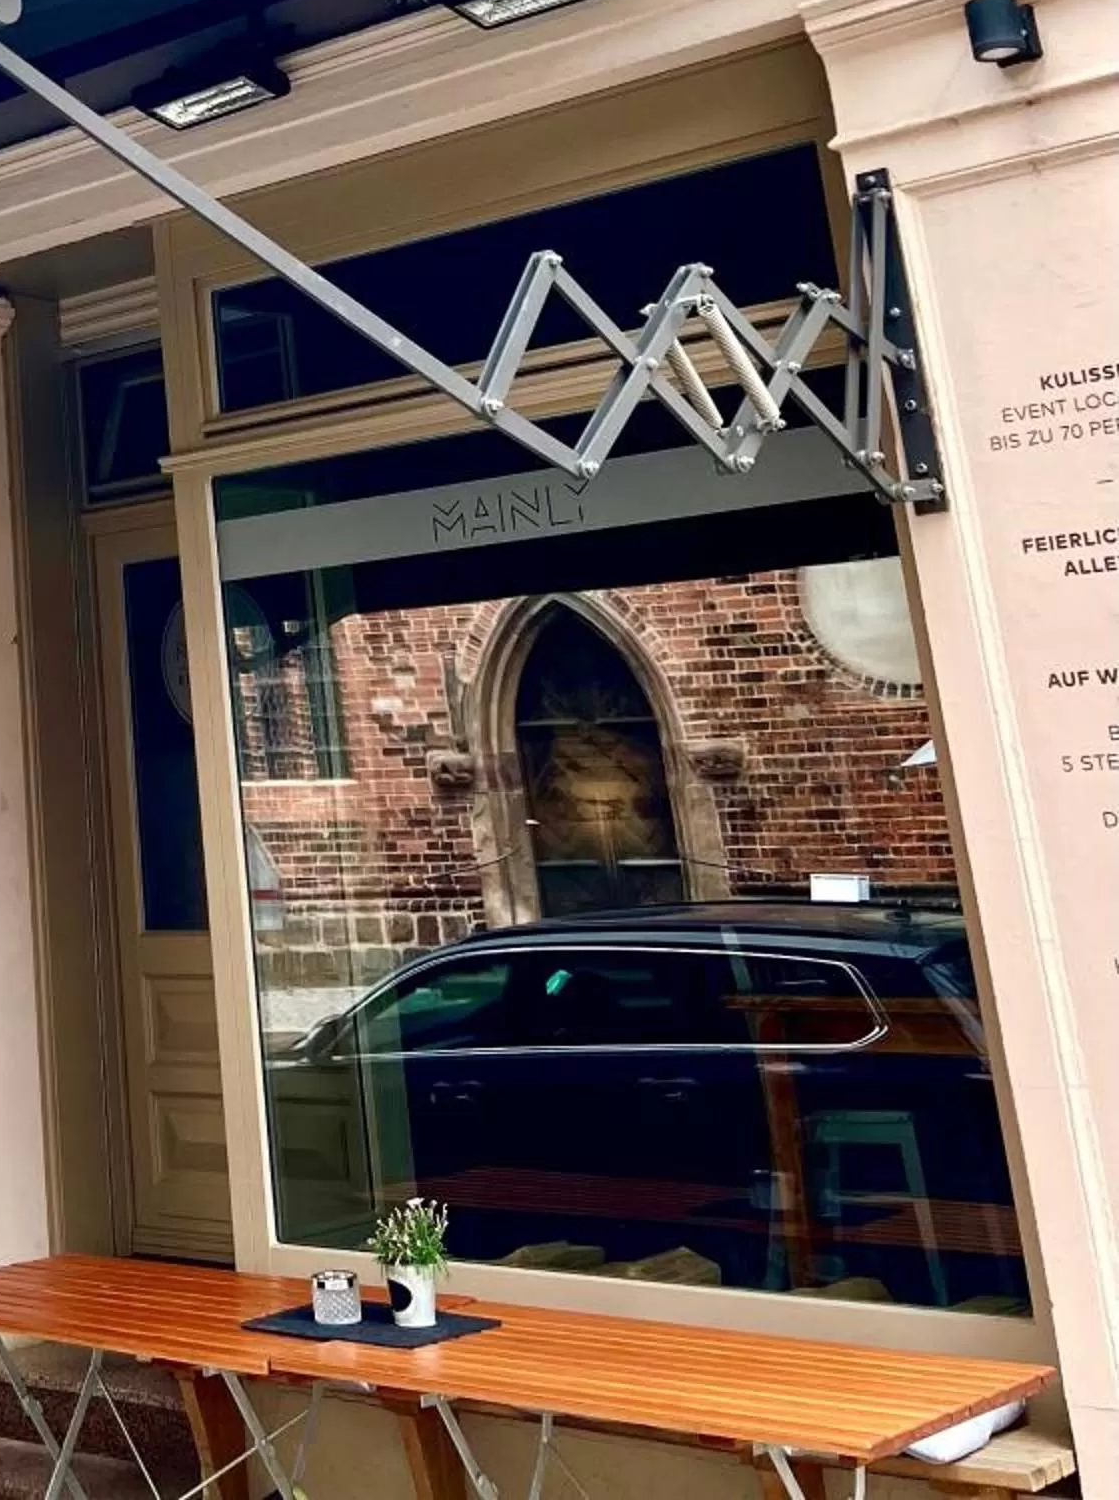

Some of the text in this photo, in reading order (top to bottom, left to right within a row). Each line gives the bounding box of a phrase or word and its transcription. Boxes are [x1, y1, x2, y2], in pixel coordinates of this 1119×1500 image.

[1039, 363, 1119, 391] KULISS
[1001, 399, 1068, 423] EVENT
[989, 433, 1022, 452] BIS
[1026, 428, 1054, 447] ZU
[1059, 423, 1084, 441] 70
[432, 479, 591, 544] MAINLY
[1022, 528, 1119, 555] FEIERLIC
[1064, 555, 1119, 577] ALLE
[1048, 670, 1090, 689] AUF
[1061, 755, 1074, 773] 5
